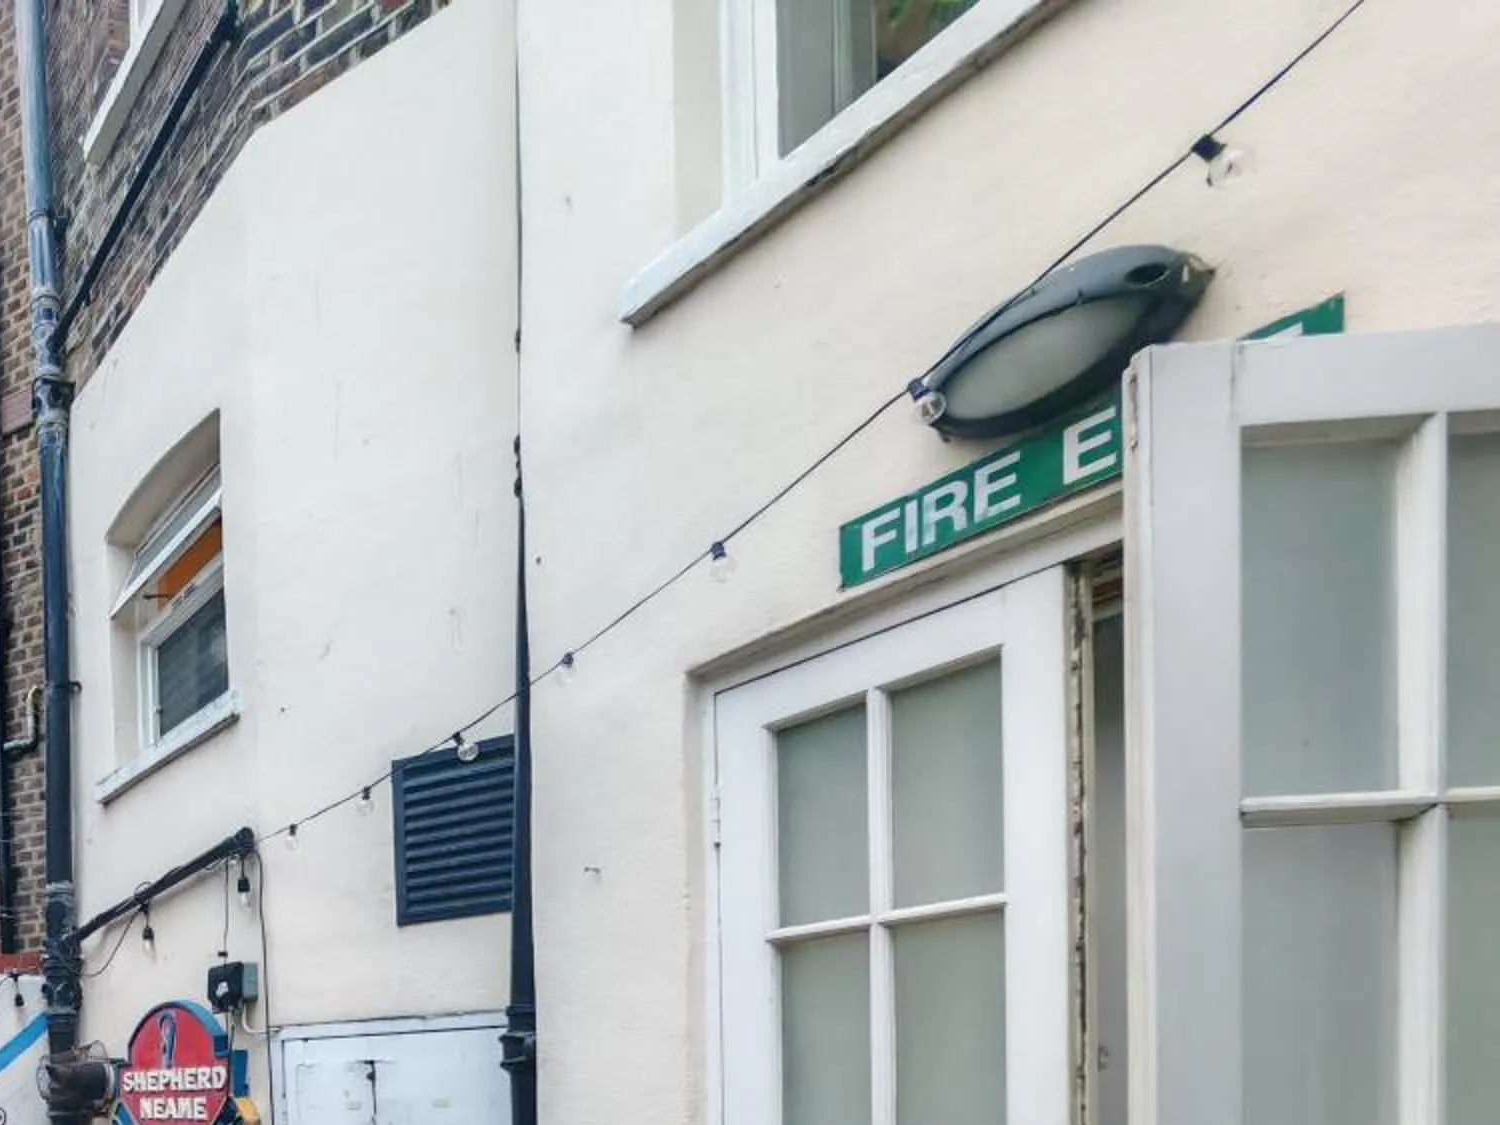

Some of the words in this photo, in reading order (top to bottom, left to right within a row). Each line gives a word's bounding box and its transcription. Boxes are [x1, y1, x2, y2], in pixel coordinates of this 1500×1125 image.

[860, 449, 1021, 572] FIRE
[123, 1066, 228, 1092] SHEPHERD
[139, 1096, 208, 1120] NEAME
